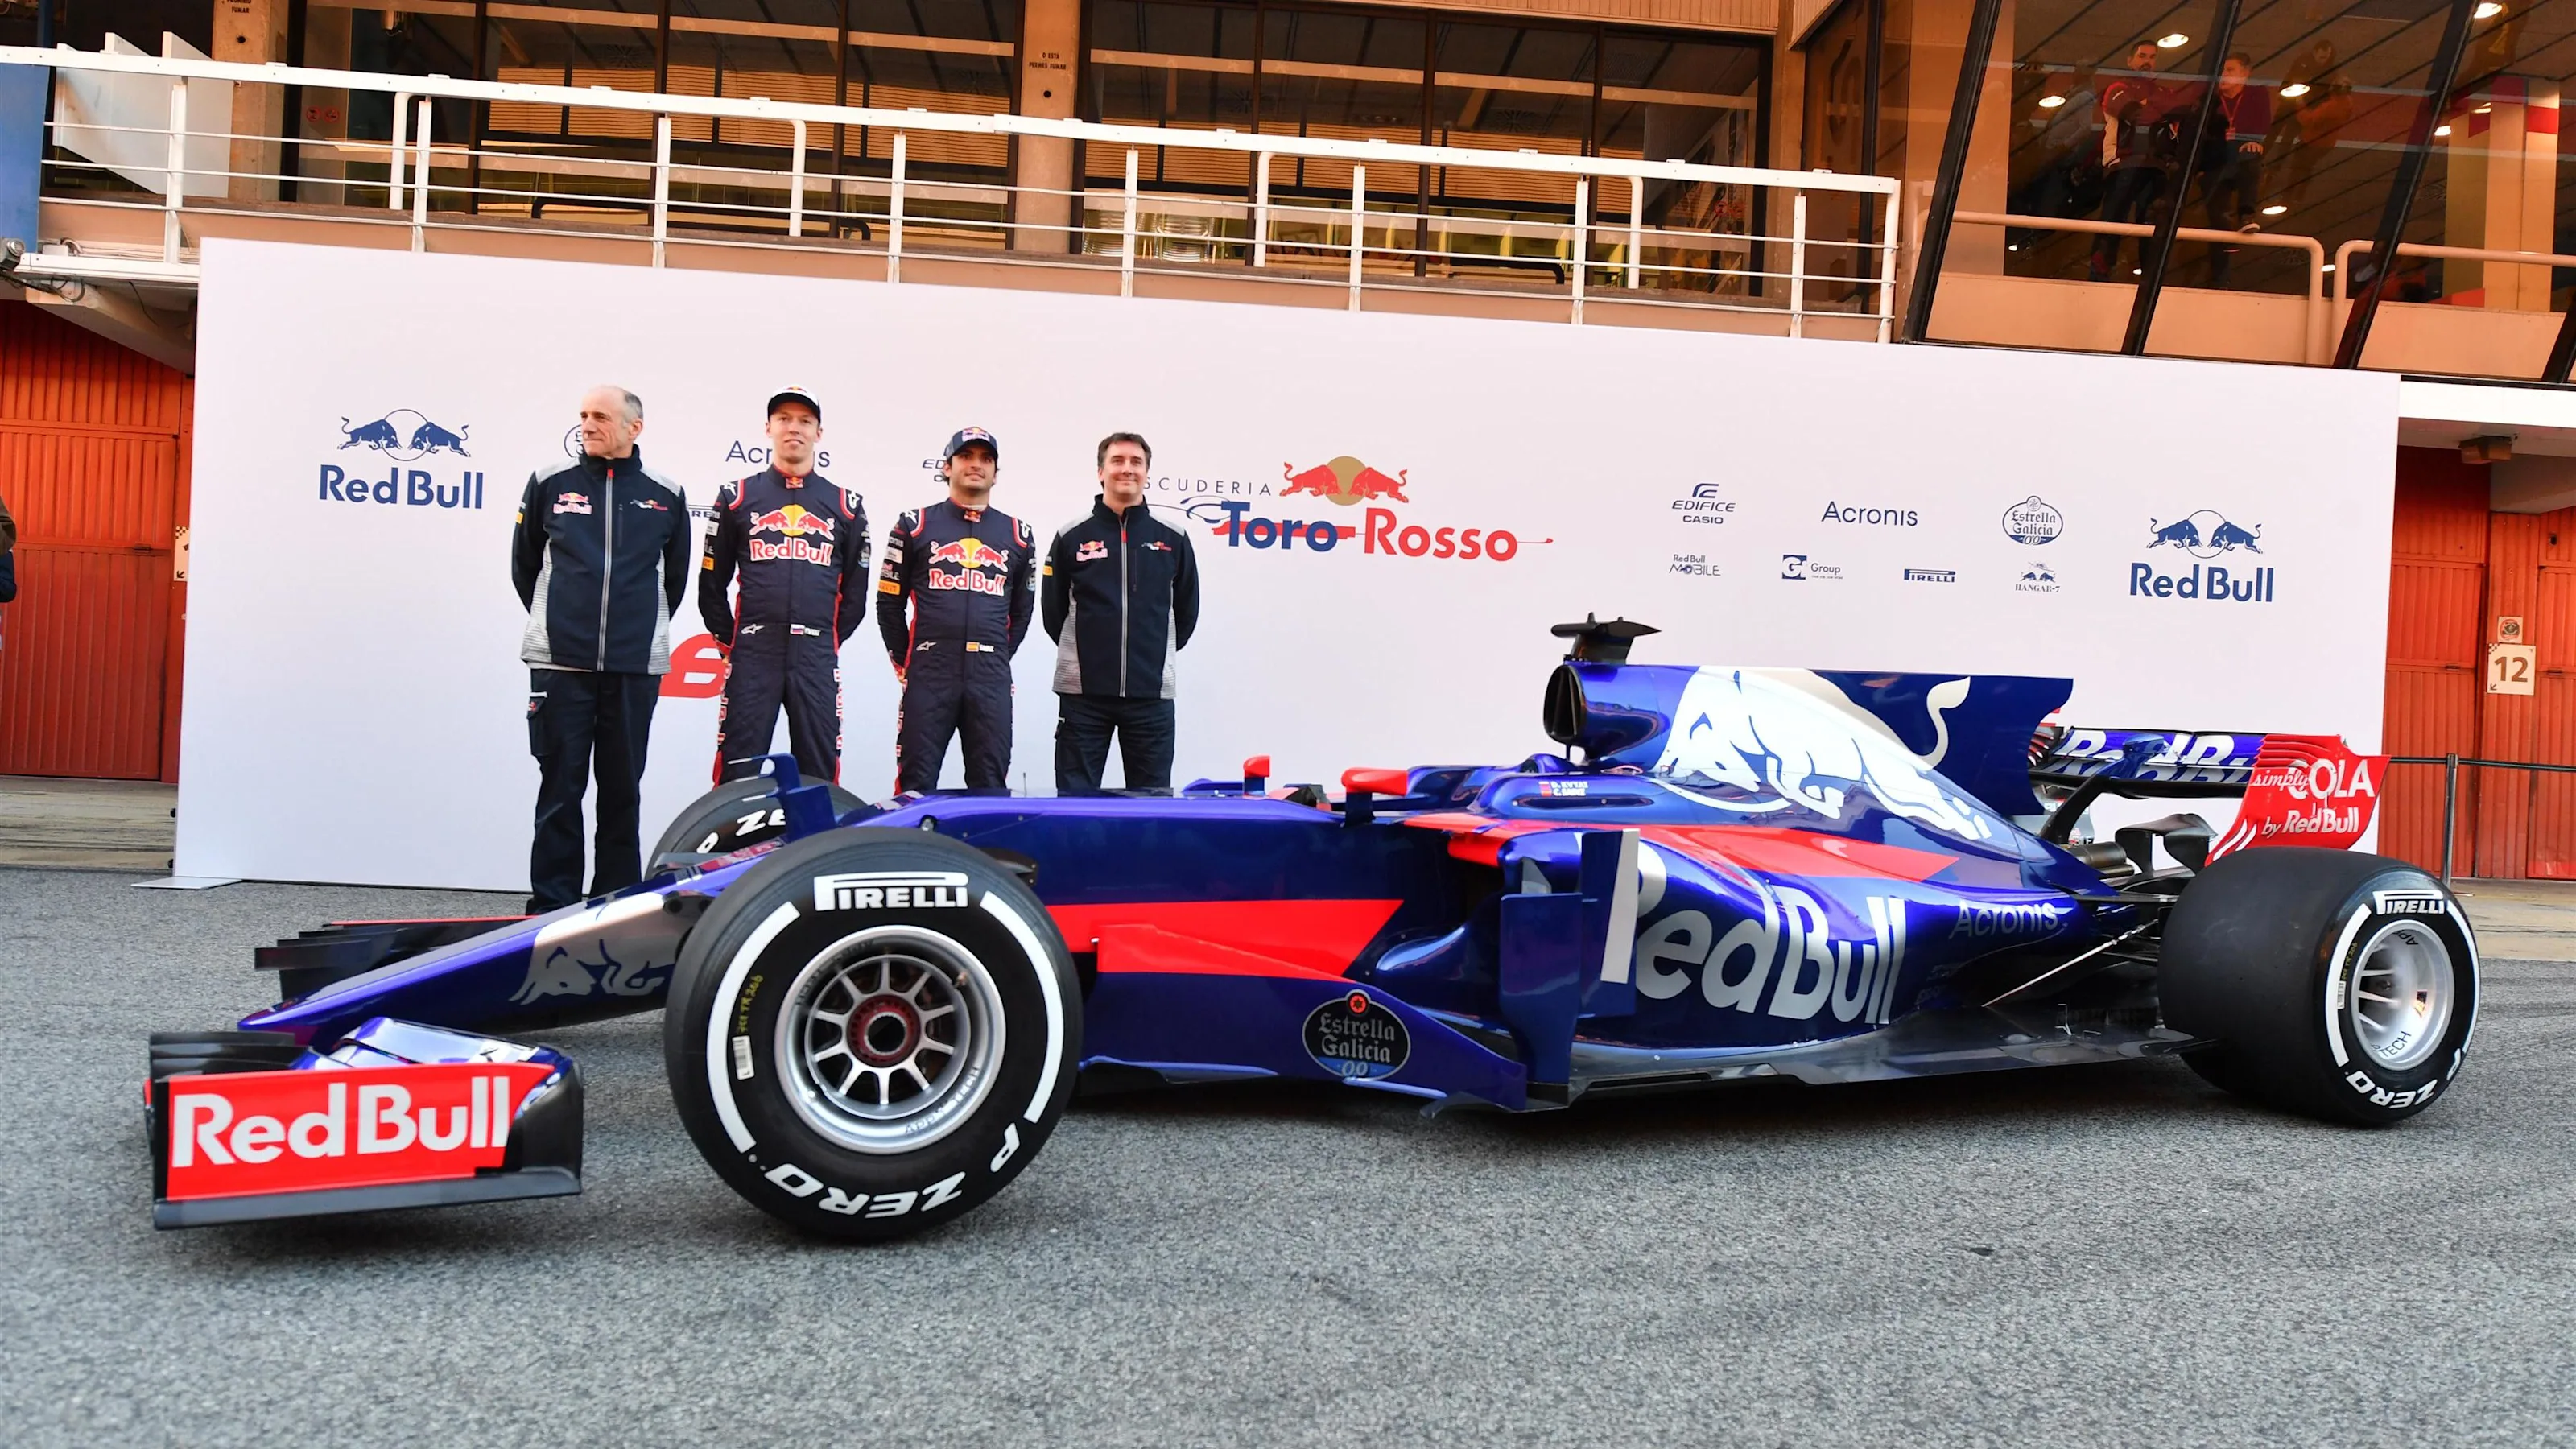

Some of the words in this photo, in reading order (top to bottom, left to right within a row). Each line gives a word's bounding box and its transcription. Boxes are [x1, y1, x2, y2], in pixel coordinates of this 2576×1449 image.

[725, 440, 831, 469] Acris
[319, 464, 399, 505] Red
[407, 469, 484, 510] Bull
[1143, 477, 1272, 497] SCUDERIA
[1671, 499, 1736, 513] EDIFICE
[1682, 514, 1724, 525] CASIO
[1821, 501, 1918, 527] Acronis
[2011, 510, 2056, 523] Estrella
[1220, 501, 1339, 552] Toro
[1364, 507, 1518, 562] Rosso
[2013, 522, 2053, 535] Galicia
[749, 537, 792, 561] Red
[792, 538, 834, 566] Bull
[1673, 554, 1690, 563] Red
[1690, 555, 1706, 564] Bull
[929, 568, 970, 590] Red
[970, 569, 1007, 596] Bull
[1669, 563, 1721, 576] MOBILE
[1810, 562, 1841, 575] Group
[1903, 568, 1956, 583] PIRELLI
[2129, 562, 2200, 599] Red
[2206, 566, 2274, 602] Bull
[2014, 583, 2061, 593] HANGAR-7
[2494, 656, 2529, 683] 12
[2252, 769, 2310, 791] simply
[2287, 758, 2376, 800] COLA
[736, 807, 786, 836] ZE
[2261, 815, 2283, 839] by
[2281, 808, 2322, 834] Red
[2322, 807, 2360, 834] Bull
[814, 871, 969, 912] PIRELLI
[2372, 889, 2445, 915] PIRELLI
[1949, 899, 2058, 940] Acronis
[1768, 885, 1906, 1025] Bull
[1318, 1012, 1395, 1041] Estrella
[1321, 1034, 1391, 1063] Galicia
[2380, 1030, 2412, 1059] TECH
[2346, 1070, 2438, 1109] ZERO
[171, 1082, 346, 1168] Red
[358, 1076, 510, 1154] Bull
[989, 1122, 1021, 1173] P
[764, 1162, 966, 1219] ZERO
